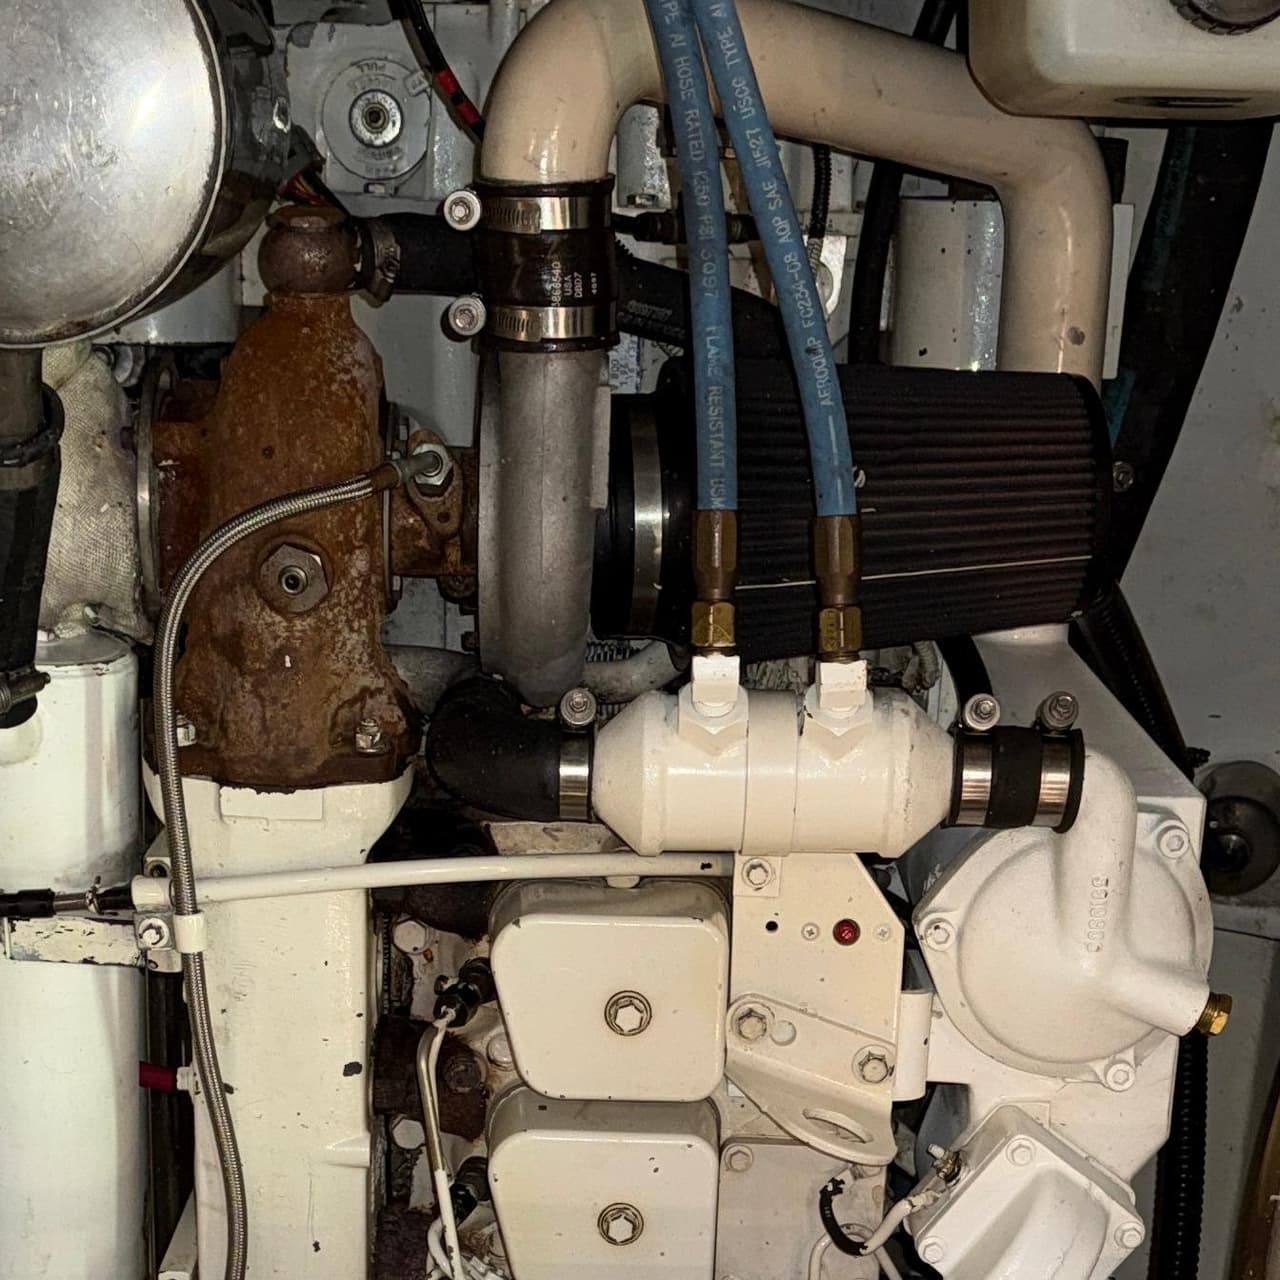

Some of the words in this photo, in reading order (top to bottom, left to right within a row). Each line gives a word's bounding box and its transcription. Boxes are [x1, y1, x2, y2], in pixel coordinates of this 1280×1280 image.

[717, 26, 741, 70] TYPE
[674, 56, 697, 100] HOSE
[684, 109, 705, 161] RATED
[762, 178, 783, 211] SAE
[708, 385, 726, 468] RESISTANT
